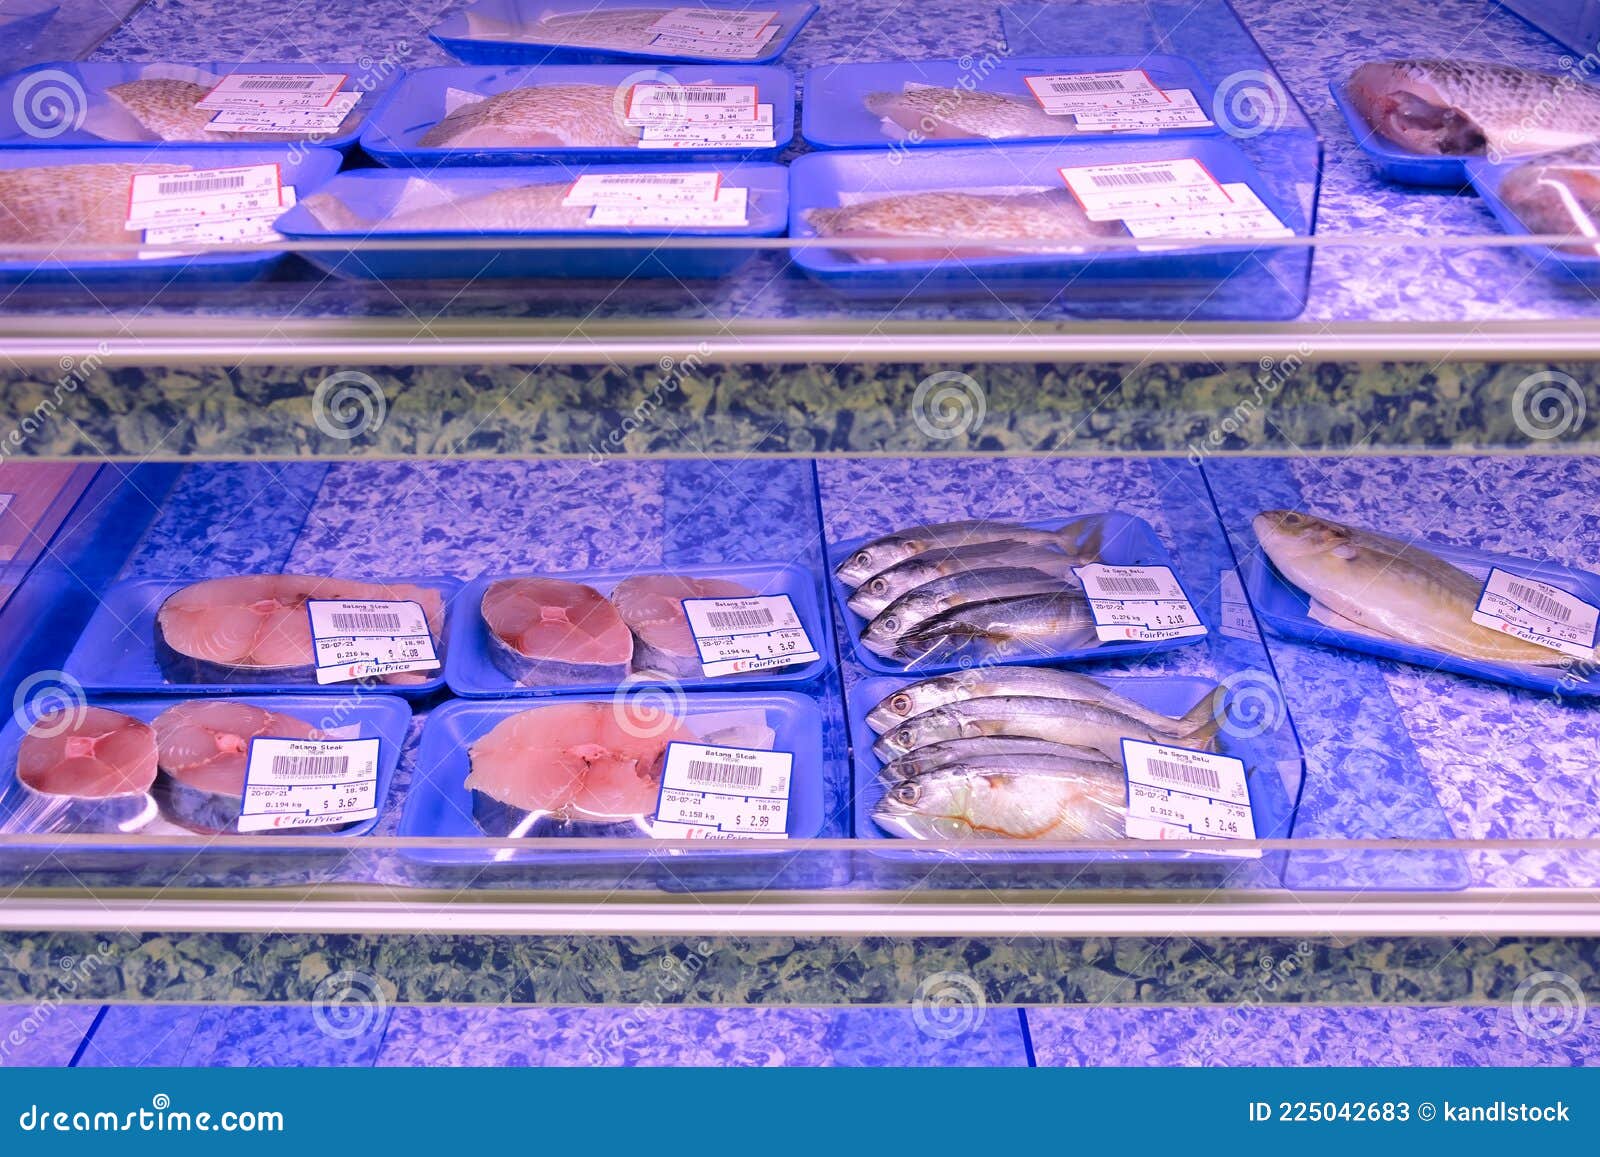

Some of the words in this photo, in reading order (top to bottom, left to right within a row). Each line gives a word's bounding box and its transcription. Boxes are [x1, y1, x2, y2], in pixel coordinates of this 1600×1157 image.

[1167, 615, 1185, 625] 2.18
[1139, 630, 1180, 639] FairPrice
[1516, 630, 1563, 648] FairPrice
[1559, 630, 1577, 640] 2.40
[321, 641, 354, 649] 20/07/21
[779, 641, 796, 651] 3.67
[336, 651, 359, 659] 0.216
[401, 648, 419, 658] 4.08
[748, 657, 791, 669] FairPrice
[365, 664, 410, 674] FairPrice
[705, 749, 732, 759] Batang
[735, 752, 757, 760] Steak
[345, 786, 369, 794] 18.90
[1135, 788, 1169, 802] 20/07/21
[338, 797, 358, 808] 3.67
[666, 794, 701, 805] 20/07/21
[757, 804, 781, 812] 18.90
[1150, 806, 1173, 817] 0.312
[1227, 808, 1246, 818] 7.90
[679, 809, 703, 818] 0.158
[291, 815, 343, 825] FairPrice
[750, 815, 770, 827] 2.99
[1218, 819, 1238, 833] 2.46
